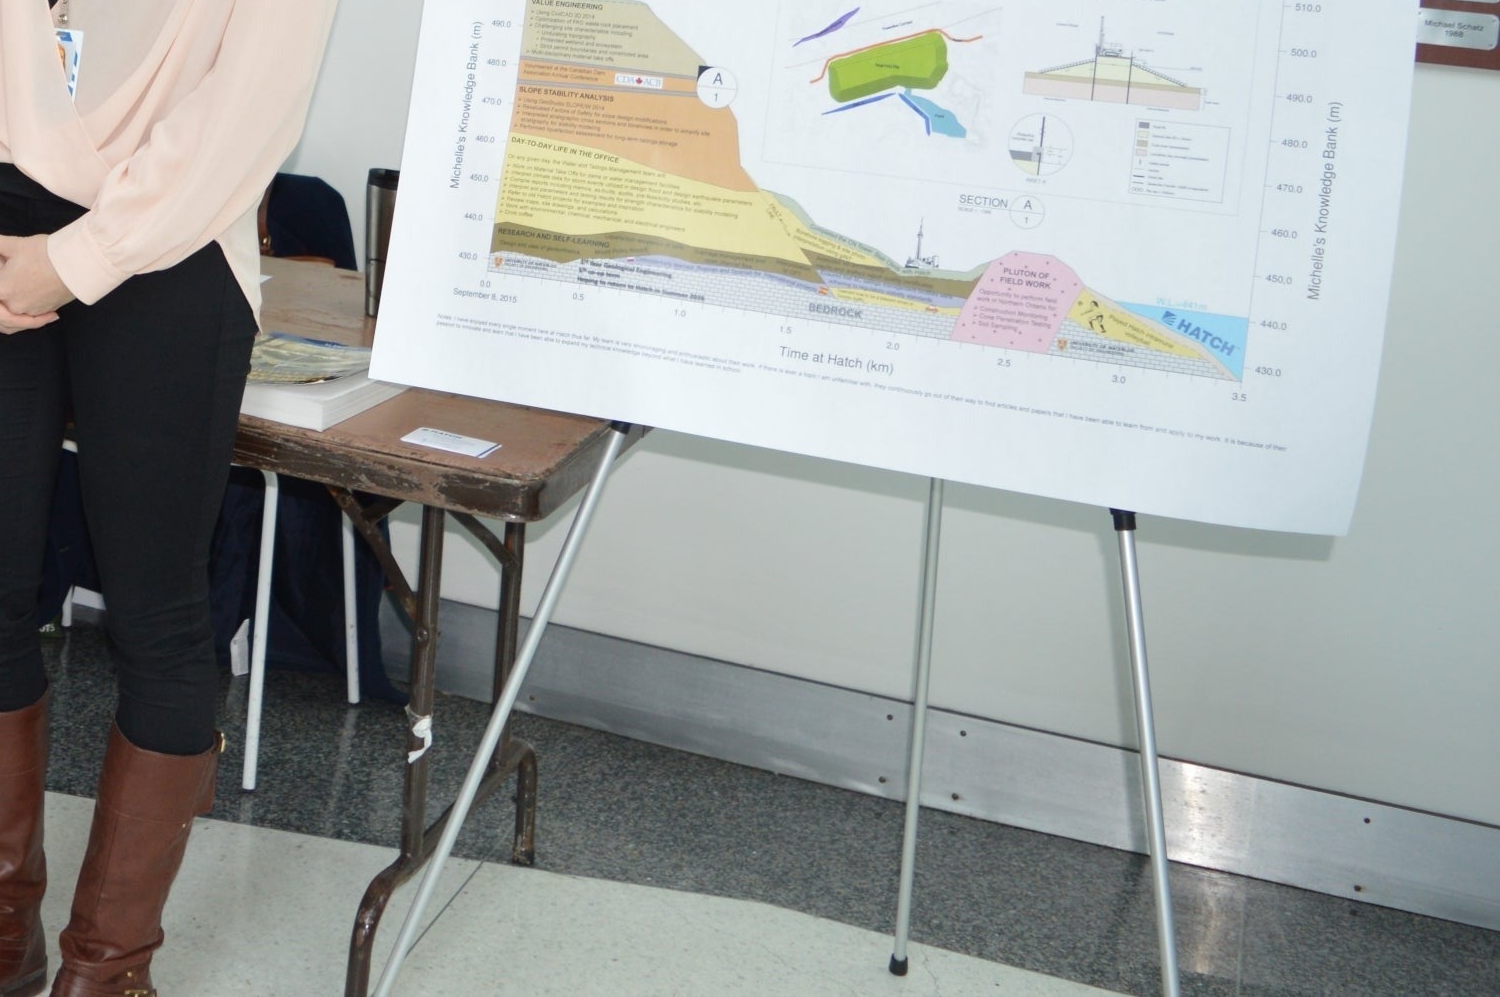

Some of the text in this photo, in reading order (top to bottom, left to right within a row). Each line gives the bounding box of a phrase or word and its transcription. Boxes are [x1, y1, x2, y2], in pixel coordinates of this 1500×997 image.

[555, 1, 603, 10] ENGINEERING
[1295, 3, 1321, 12] 510.0
[1290, 48, 1317, 57] 500.0
[487, 58, 506, 66] 480.0
[714, 74, 723, 83] A
[519, 86, 614, 102] SLOPE STABILITY ANALYSIS
[1285, 94, 1312, 103] 490.0
[450, 21, 484, 189] Michelle's Knowledge Bank (m)
[482, 97, 501, 105] 470.0
[476, 135, 494, 143] 460.0
[1281, 139, 1308, 148] 480.0
[511, 137, 551, 149] DAY-TO-DAY
[553, 145, 568, 153] LIFE
[593, 153, 619, 162] OFFICE
[1276, 184, 1302, 193] 470.0
[958, 194, 1008, 208] SECTION
[1023, 200, 1033, 210] A
[1307, 101, 1343, 300] Michelle's Knowledge Bank (m)
[463, 213, 482, 221] 440.0
[1271, 229, 1297, 238] 460.0
[498, 228, 533, 237] RESEARCH
[553, 235, 609, 249] SELF-LEARNING
[458, 252, 477, 260] 430.0
[1003, 268, 1036, 277] PLUTON
[999, 276, 1051, 289] FIELD WORK
[453, 288, 489, 299] September
[499, 295, 516, 304] 2015
[808, 302, 862, 318] BEDROCK
[1260, 320, 1287, 330] 440.0
[780, 326, 791, 334] 1.5
[1176, 319, 1236, 357] HATCH
[886, 342, 900, 350] 2.0
[778, 346, 894, 375] Time at Hatch (km)
[997, 359, 1011, 367] 2.5
[1112, 375, 1125, 383] 3.0
[1231, 392, 1247, 401] 3.5
